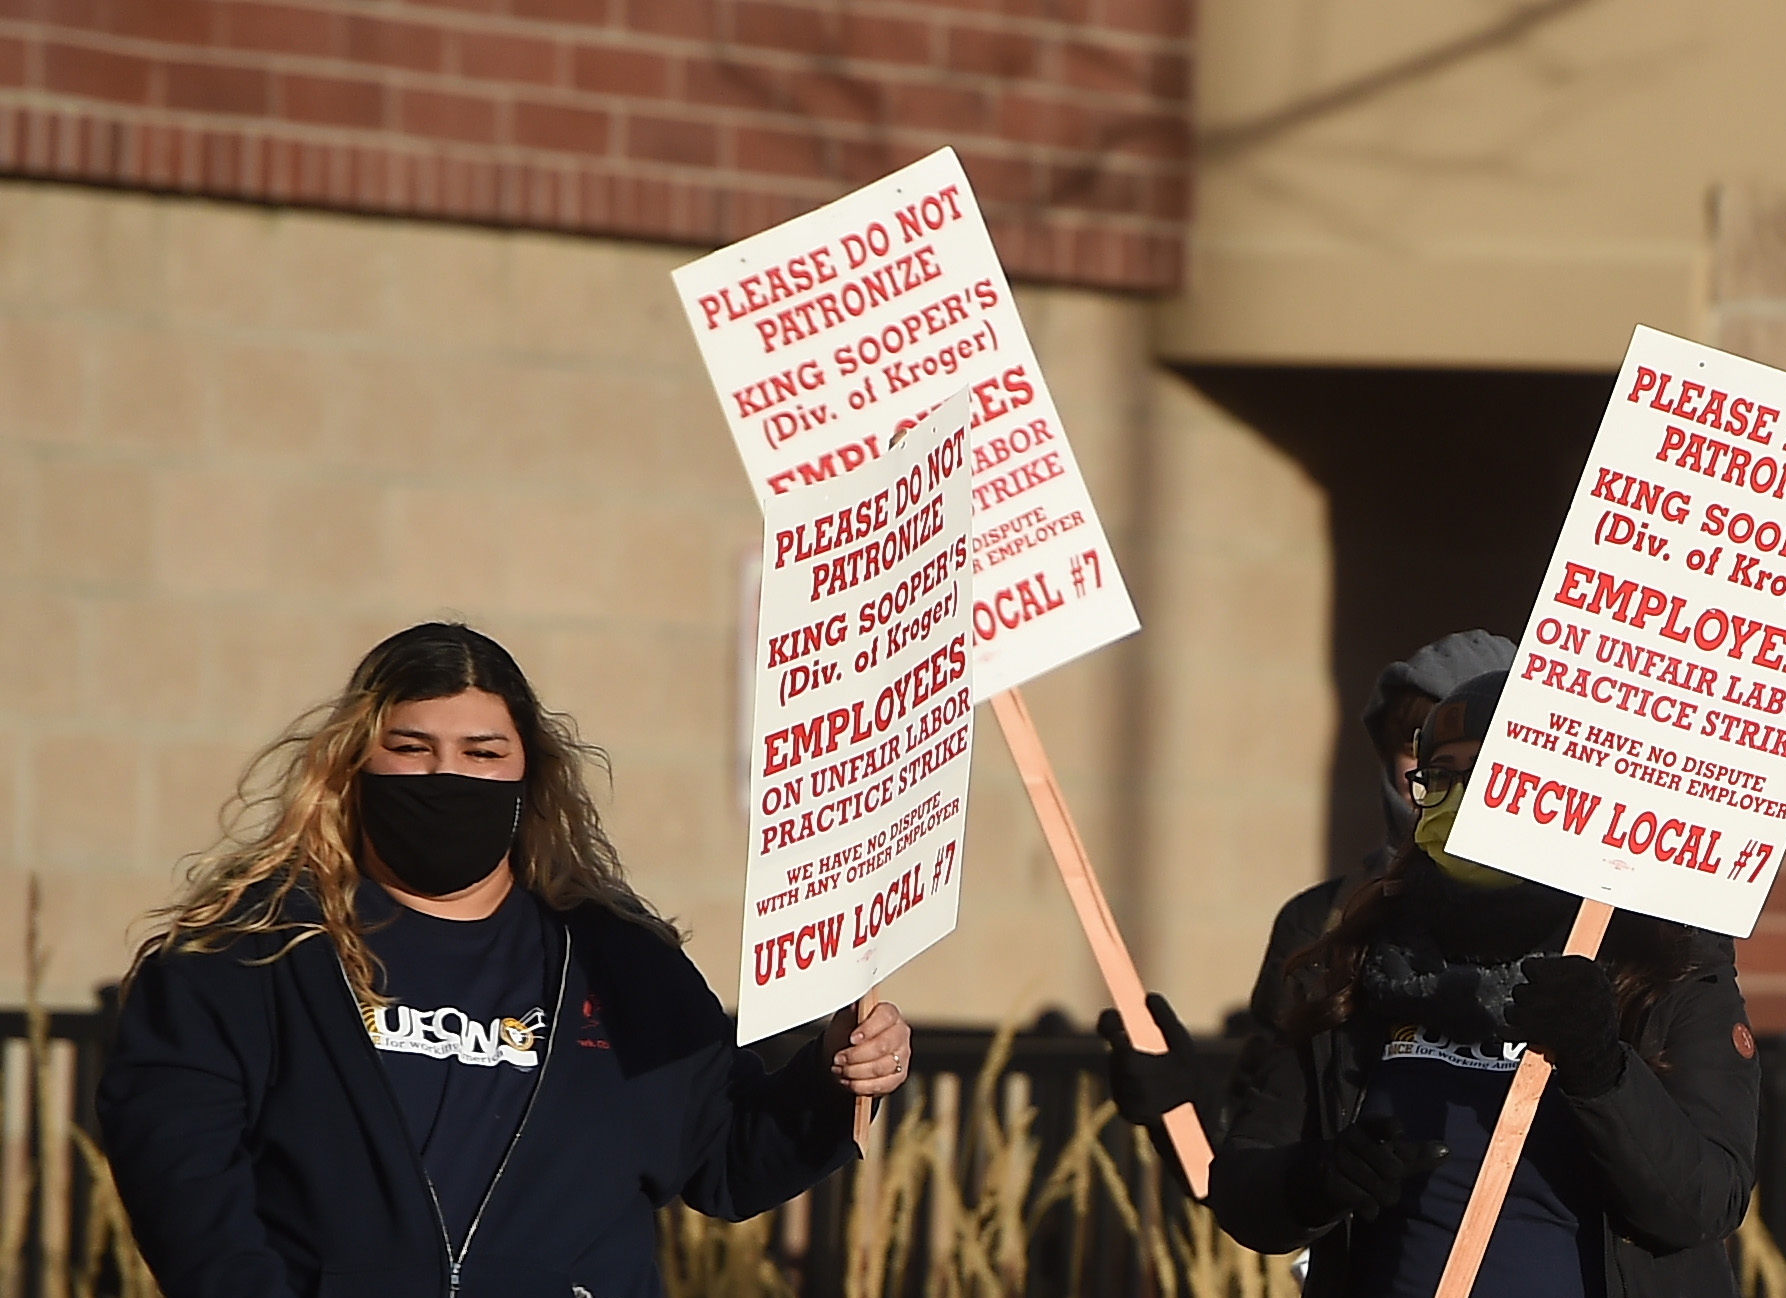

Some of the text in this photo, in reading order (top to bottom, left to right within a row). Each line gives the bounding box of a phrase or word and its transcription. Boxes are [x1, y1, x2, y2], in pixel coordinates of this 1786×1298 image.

[699, 185, 961, 329] PLEASE DO NOT
[756, 245, 942, 353] PATRONIZE
[733, 279, 997, 418] KING SOOPER'S
[764, 320, 997, 449] (Div. of Kroger)
[972, 418, 1055, 476] ABOR
[1628, 366, 1779, 445] PLEASE
[776, 426, 963, 569] PLEASE DO NOT
[972, 451, 1065, 517] TRIKE
[972, 507, 1048, 553] DISPUTE
[1591, 468, 1690, 524] KING
[811, 494, 942, 601] PATRONIZE
[987, 512, 1084, 565] EMPLOYER
[1596, 511, 1669, 560] (Div.
[1687, 548, 1722, 575] of
[769, 535, 965, 668] KING SOOPER'S
[781, 581, 956, 706] (Div. of Kroger)
[972, 549, 1101, 646] OCAL #7
[764, 633, 964, 777] EMPLOYEES
[1522, 654, 1697, 730] PRACTICE
[1537, 619, 1590, 654] ON
[1597, 635, 1717, 696] UNFAIR
[761, 724, 967, 855] PRACTICE STRIKE
[763, 688, 969, 814] ON UNFAIR LABOR
[1508, 721, 1559, 751] WITH
[1563, 741, 1609, 766] ANY
[1615, 759, 1681, 790] OTHER
[1551, 714, 1766, 792] WE HAVE NO DISPUTE
[757, 798, 958, 916] WITH ANY OTHER EMPLOYER
[788, 792, 940, 885] WE HAVE NO DISPUTE
[1485, 763, 1773, 882] UFCW LOCAL #7
[755, 840, 955, 985] UFCW LOCAL #7
[1415, 1045, 1435, 1055] for
[1438, 1050, 1490, 1069] working
